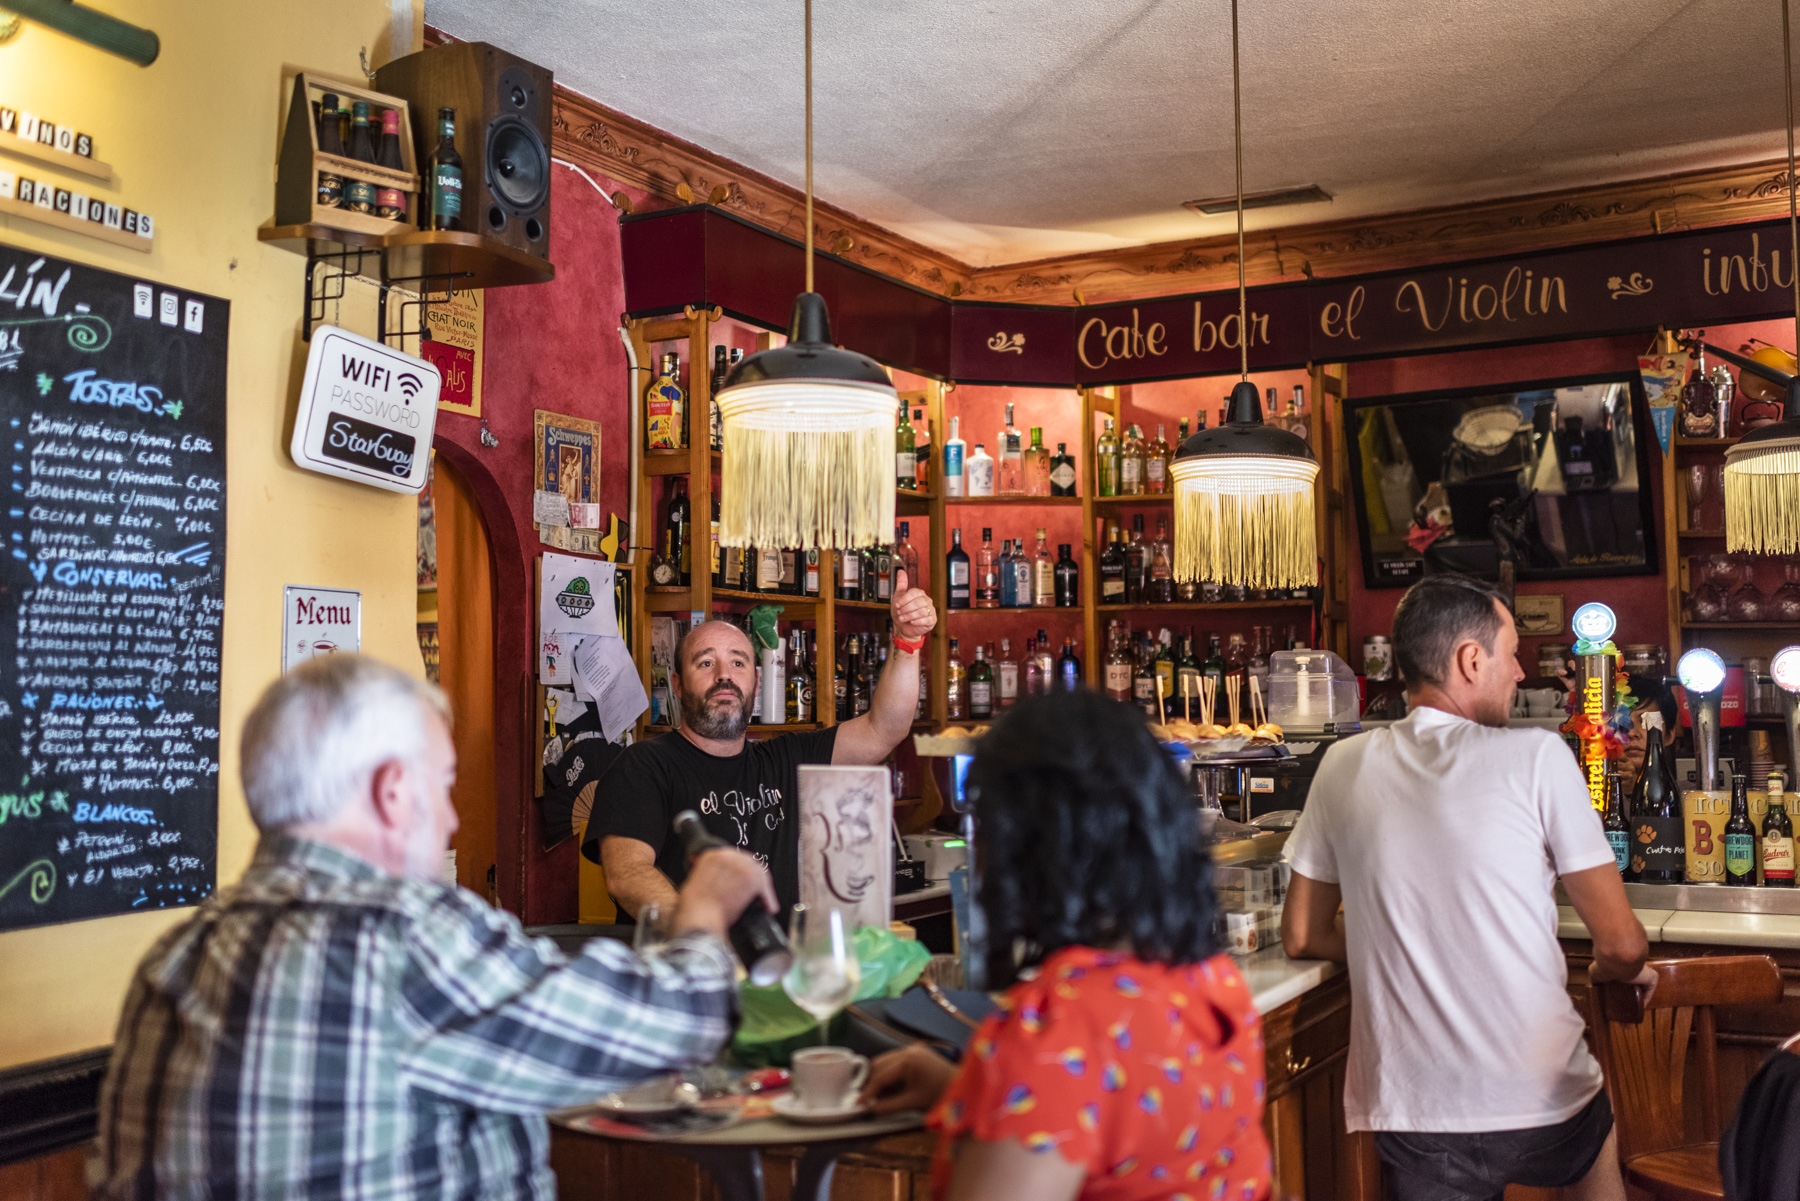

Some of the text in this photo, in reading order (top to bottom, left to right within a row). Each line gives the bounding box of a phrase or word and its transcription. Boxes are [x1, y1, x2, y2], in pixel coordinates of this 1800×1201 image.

[0, 109, 91, 157] VINOS
[19, 179, 153, 235] RACIONES
[1320, 265, 1568, 340] el Violin
[428, 310, 477, 334] CHAT NOIR
[446, 335, 475, 348] PARIS
[1078, 302, 1270, 369] Cafe bar
[456, 350, 472, 362] AVEC
[341, 353, 391, 393] WIFI
[330, 384, 421, 429] PASSWORD
[547, 426, 592, 447] Schweppes
[25, 481, 116, 505] BOQUERONES
[29, 505, 87, 526] CECINA
[93, 513, 114, 526] DE
[111, 593, 128, 604] EN
[103, 604, 121, 618] EN
[296, 596, 352, 625] Menu
[1110, 669, 1129, 680] DYC
[1583, 676, 1603, 725] alicia
[86, 726, 104, 740] DE
[91, 742, 113, 754] DE
[100, 759, 118, 771] DE
[700, 783, 782, 817] el Violin
[1728, 849, 1749, 859] PLANET
